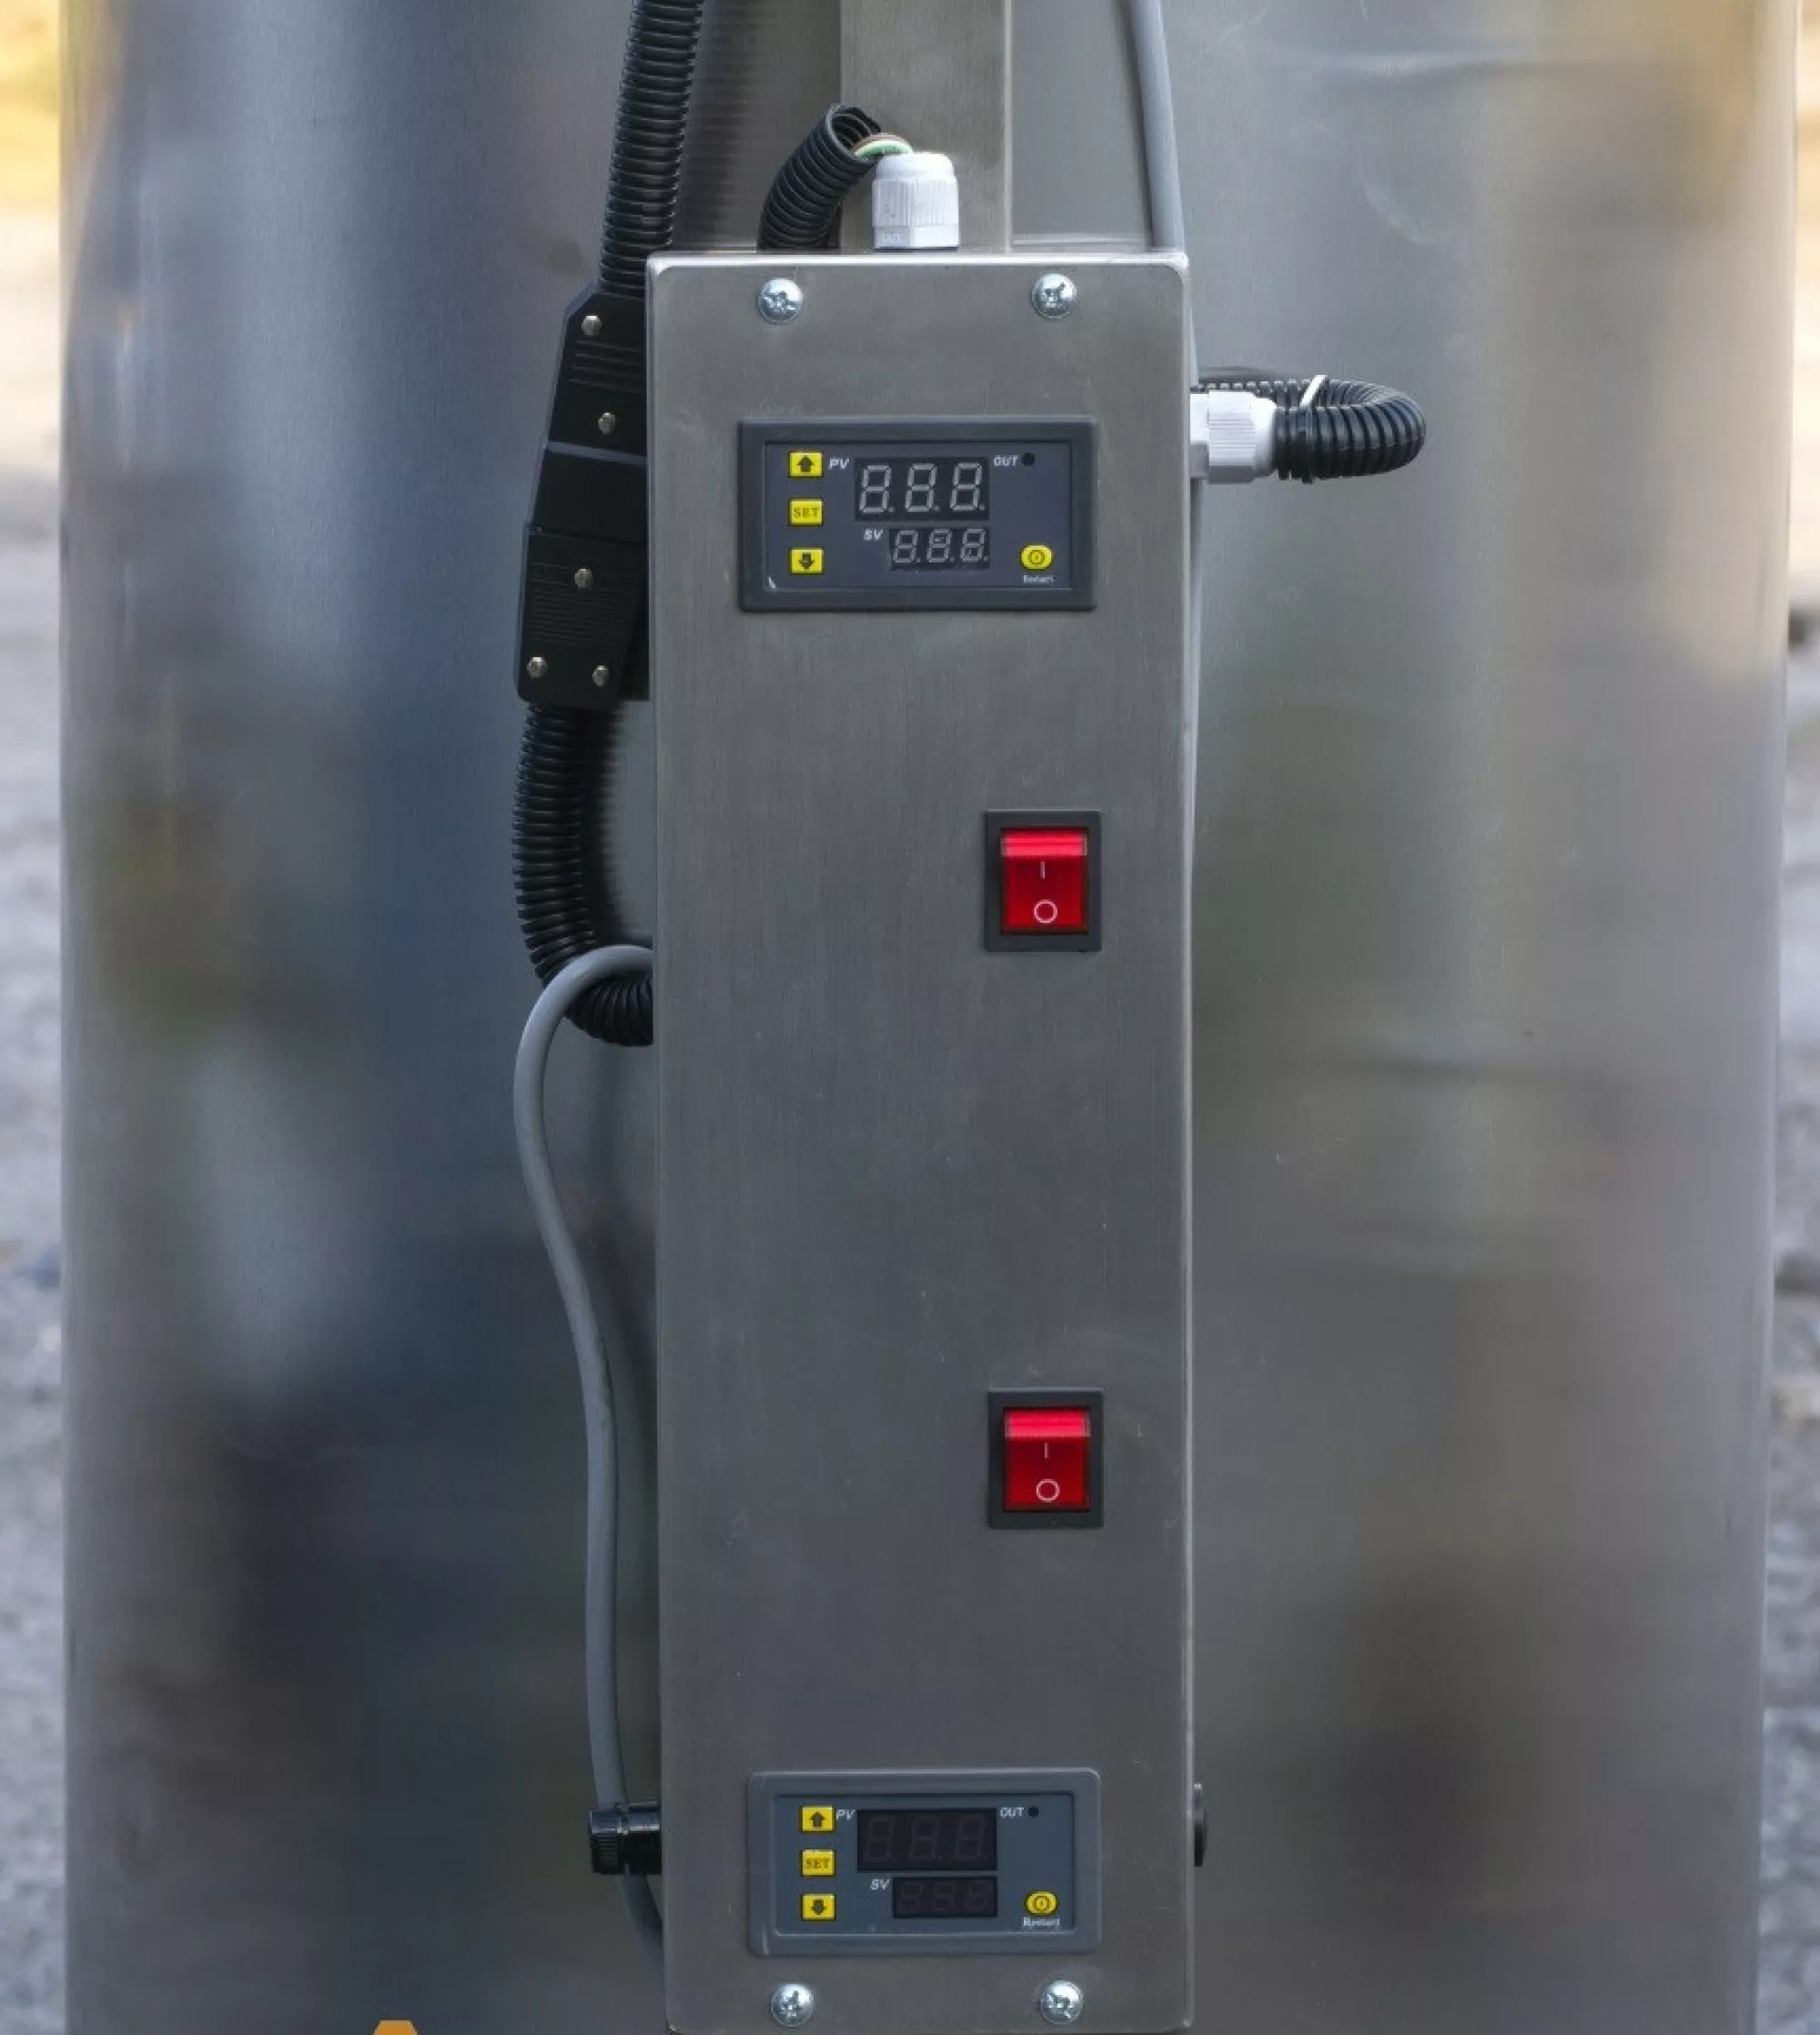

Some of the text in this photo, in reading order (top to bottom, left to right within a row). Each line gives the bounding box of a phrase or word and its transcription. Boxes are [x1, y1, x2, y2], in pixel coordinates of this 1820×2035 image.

[828, 458, 850, 471] PV
[993, 456, 1019, 467] OUT
[794, 507, 821, 519] SET
[863, 529, 884, 542] SV
[835, 1808, 856, 1821] PV
[999, 1807, 1025, 1818] OUT
[805, 1857, 831, 1869] SET
[869, 1878, 891, 1891] SV
